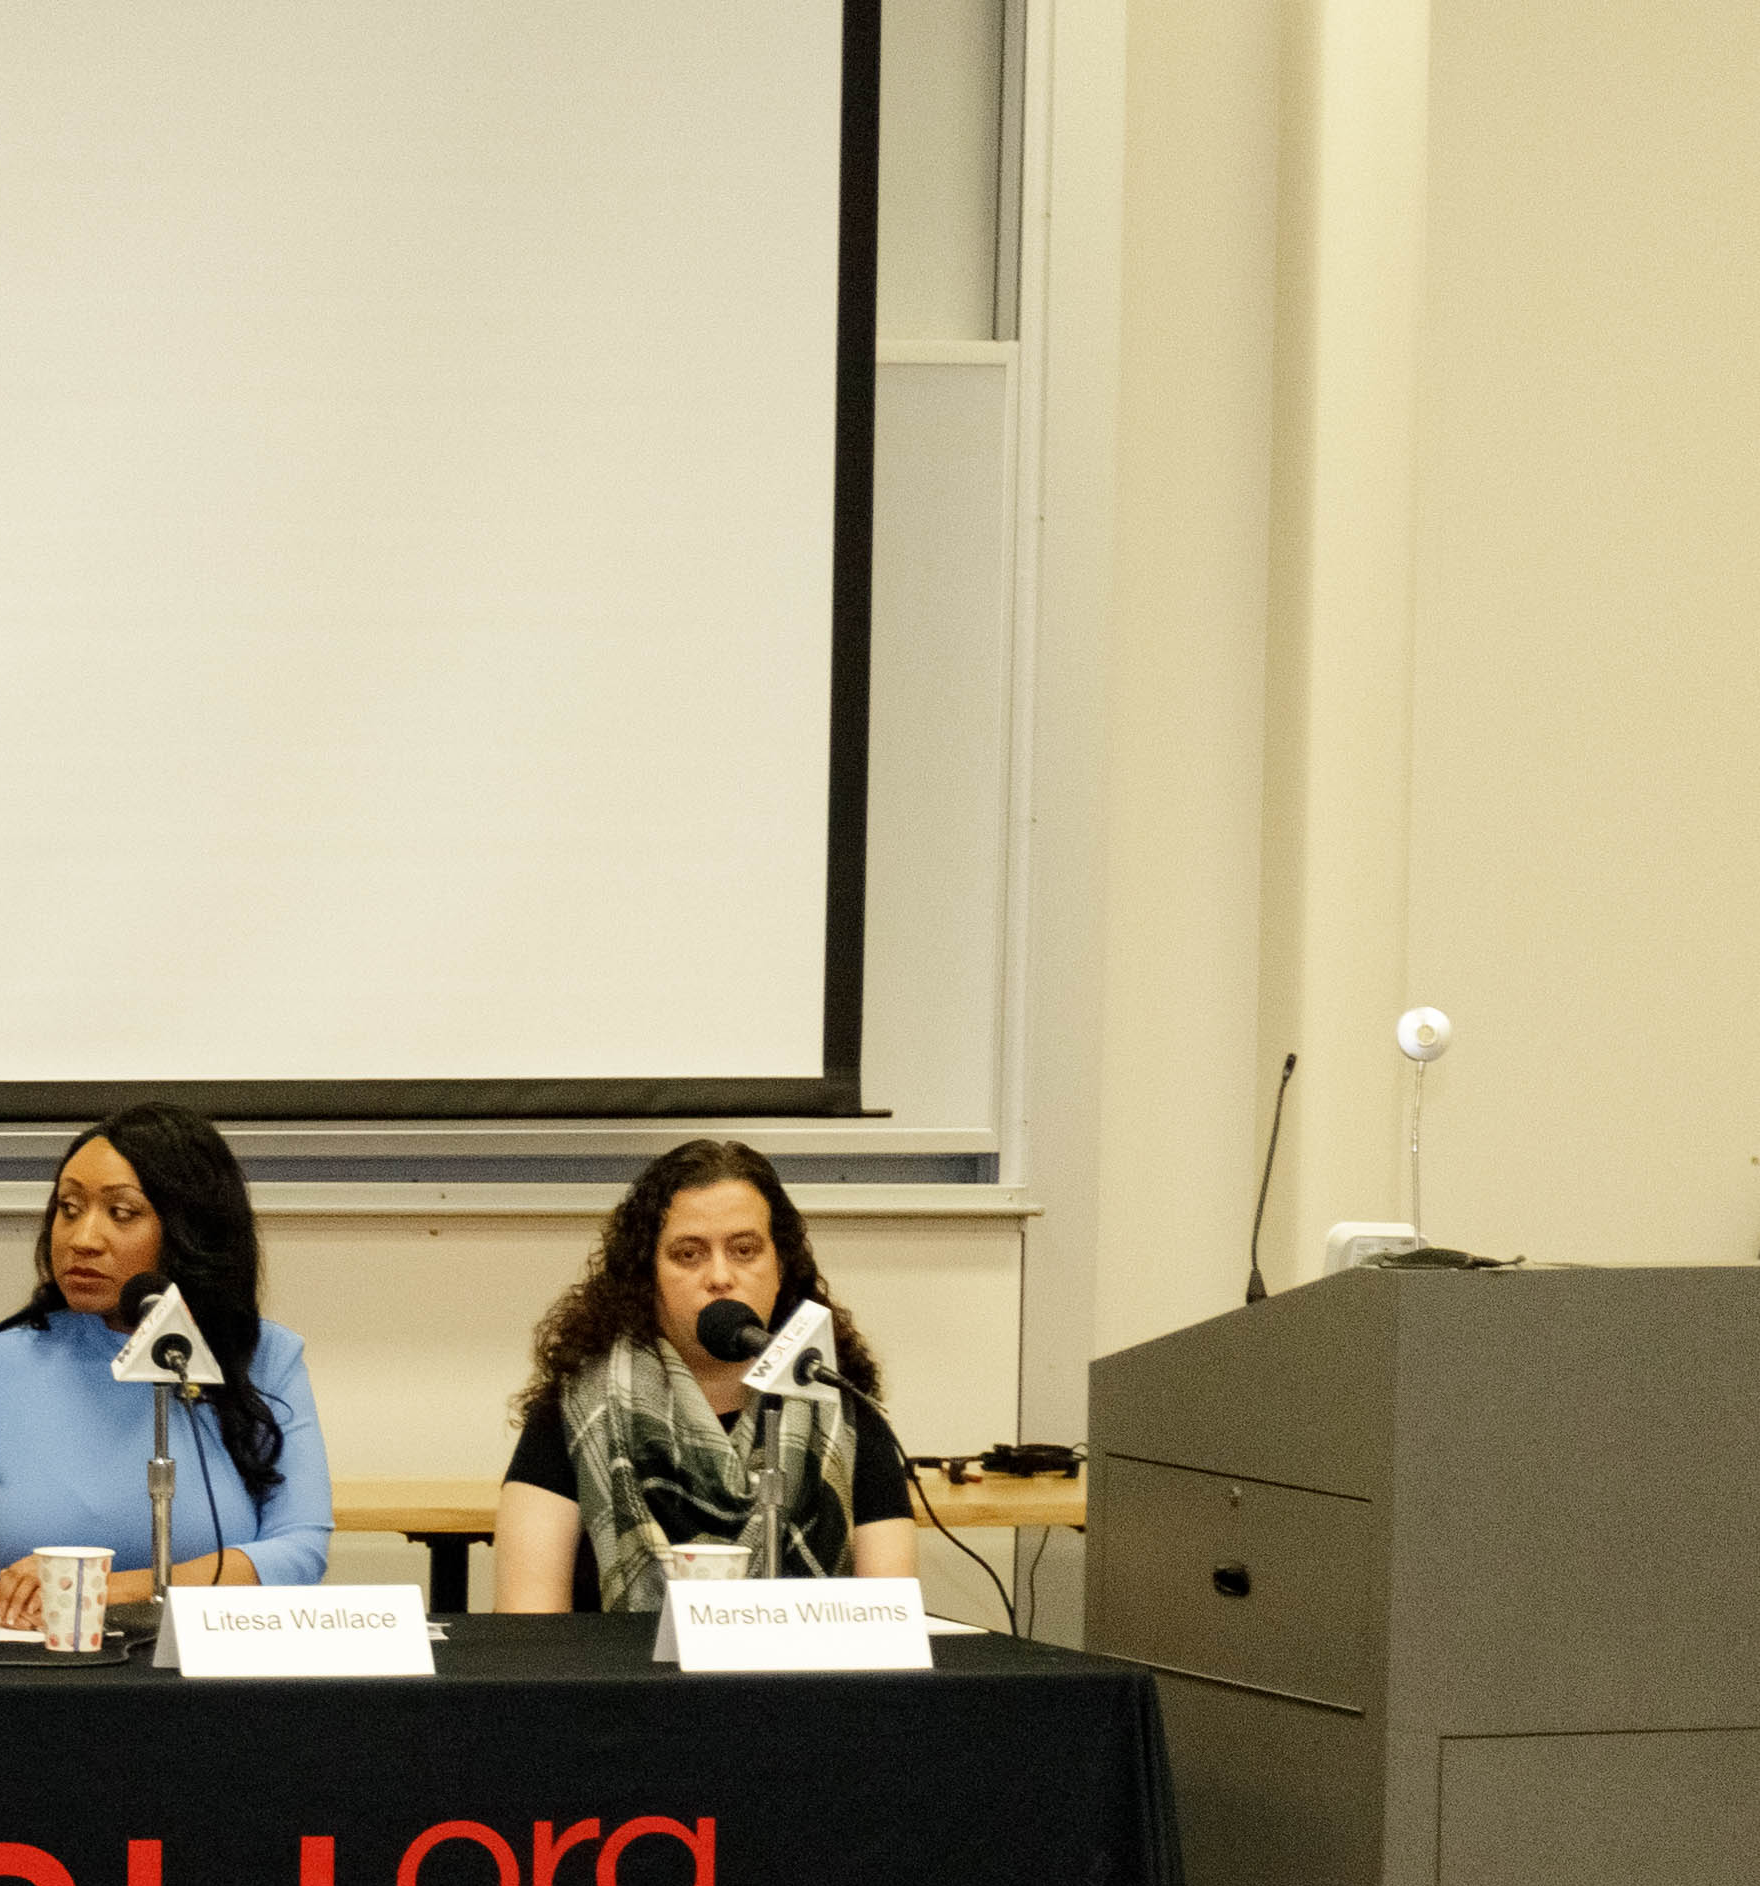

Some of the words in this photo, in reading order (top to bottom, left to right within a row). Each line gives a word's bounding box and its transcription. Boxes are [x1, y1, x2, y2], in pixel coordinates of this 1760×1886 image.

[203, 1606, 282, 1632] Litesa
[290, 1605, 397, 1631] Wallace
[689, 1601, 789, 1626] Marsha
[796, 1600, 908, 1625] Williams
